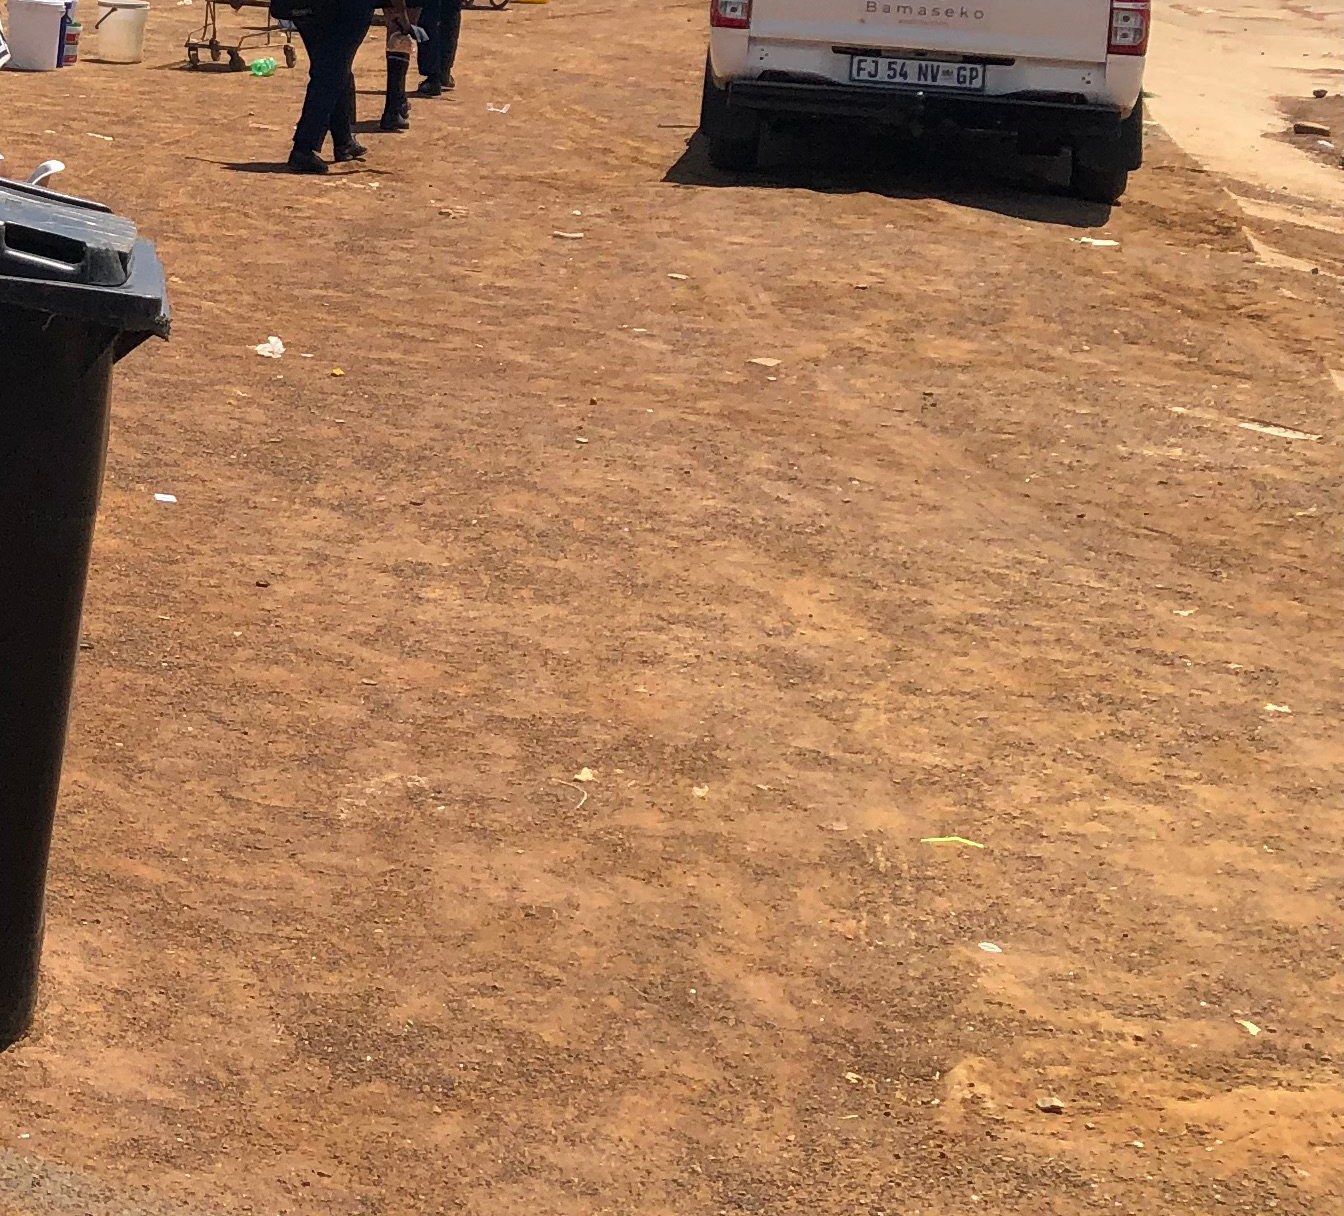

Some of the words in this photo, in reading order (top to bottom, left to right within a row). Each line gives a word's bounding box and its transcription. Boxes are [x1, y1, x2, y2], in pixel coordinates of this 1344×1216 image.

[865, 0, 984, 20] Bamaseko
[856, 58, 879, 78] FJ
[886, 61, 909, 80] 54
[917, 63, 940, 82] NV
[956, 66, 979, 86] GP
